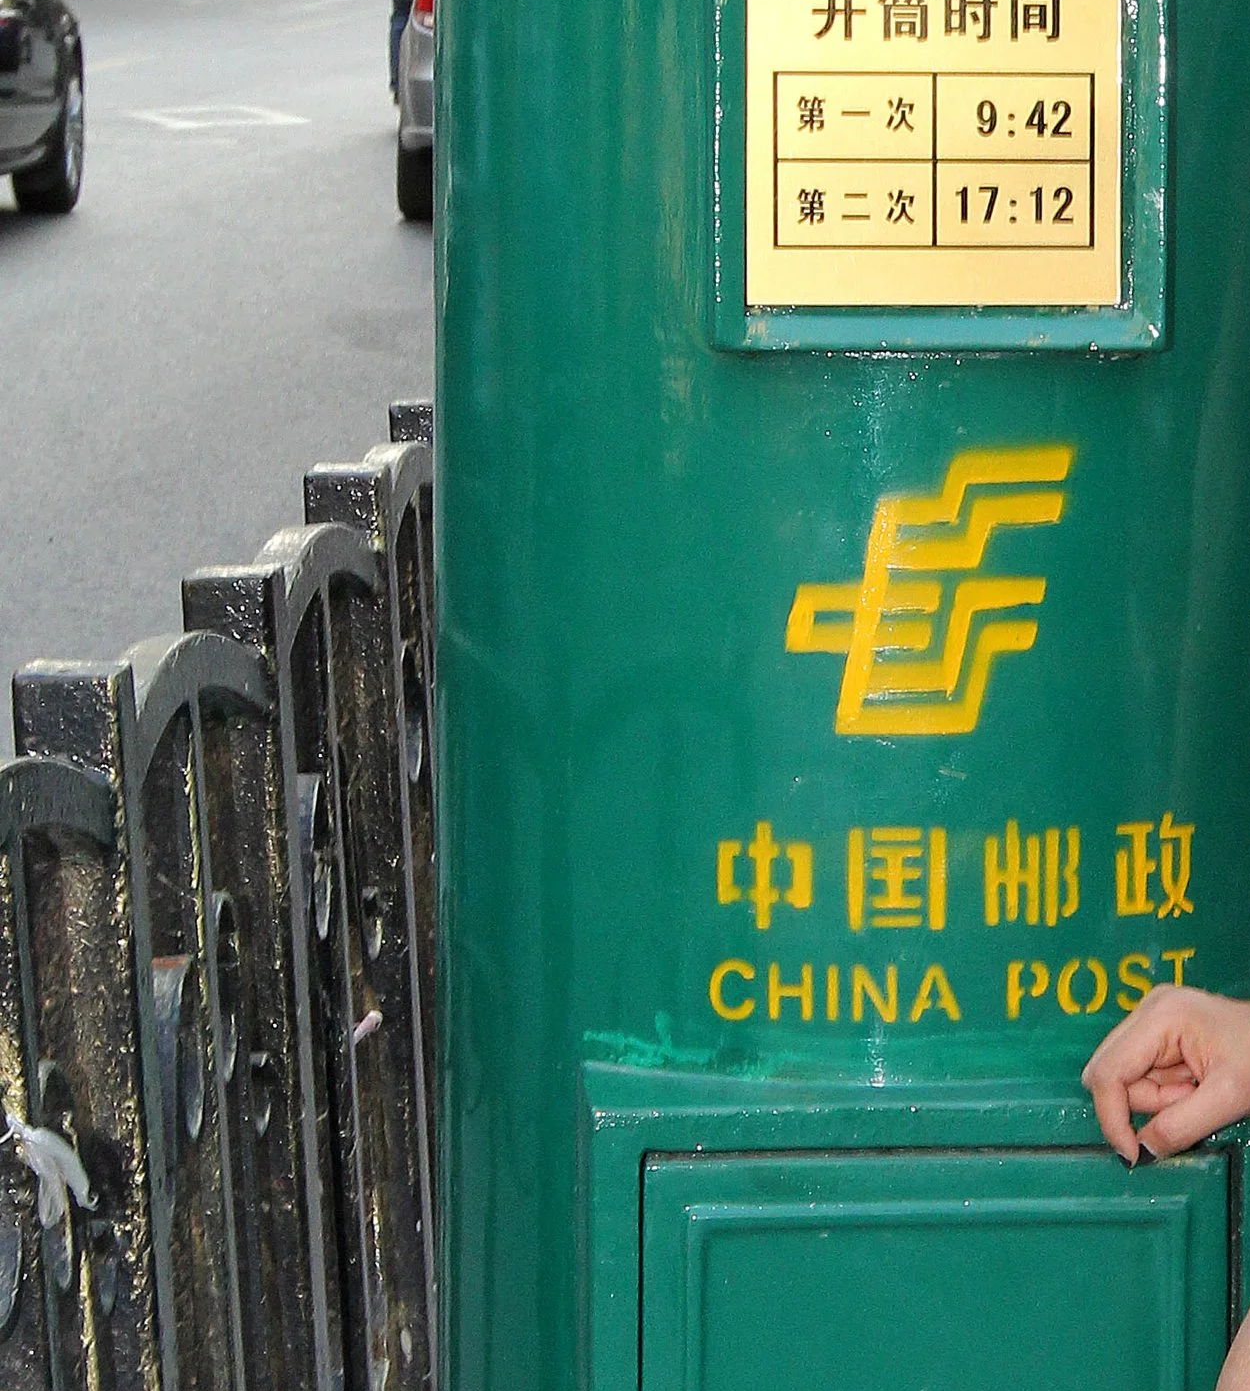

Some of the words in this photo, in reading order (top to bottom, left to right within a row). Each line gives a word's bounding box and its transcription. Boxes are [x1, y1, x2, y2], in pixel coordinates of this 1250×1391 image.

[797, 96, 916, 133] 第一次
[976, 100, 1072, 139] 9:42
[797, 188, 916, 226] 第二次
[954, 186, 1074, 225] 17:12
[716, 811, 1196, 930] 中国邮政
[709, 959, 962, 1022] CHINA
[1007, 947, 1196, 1020] POST
